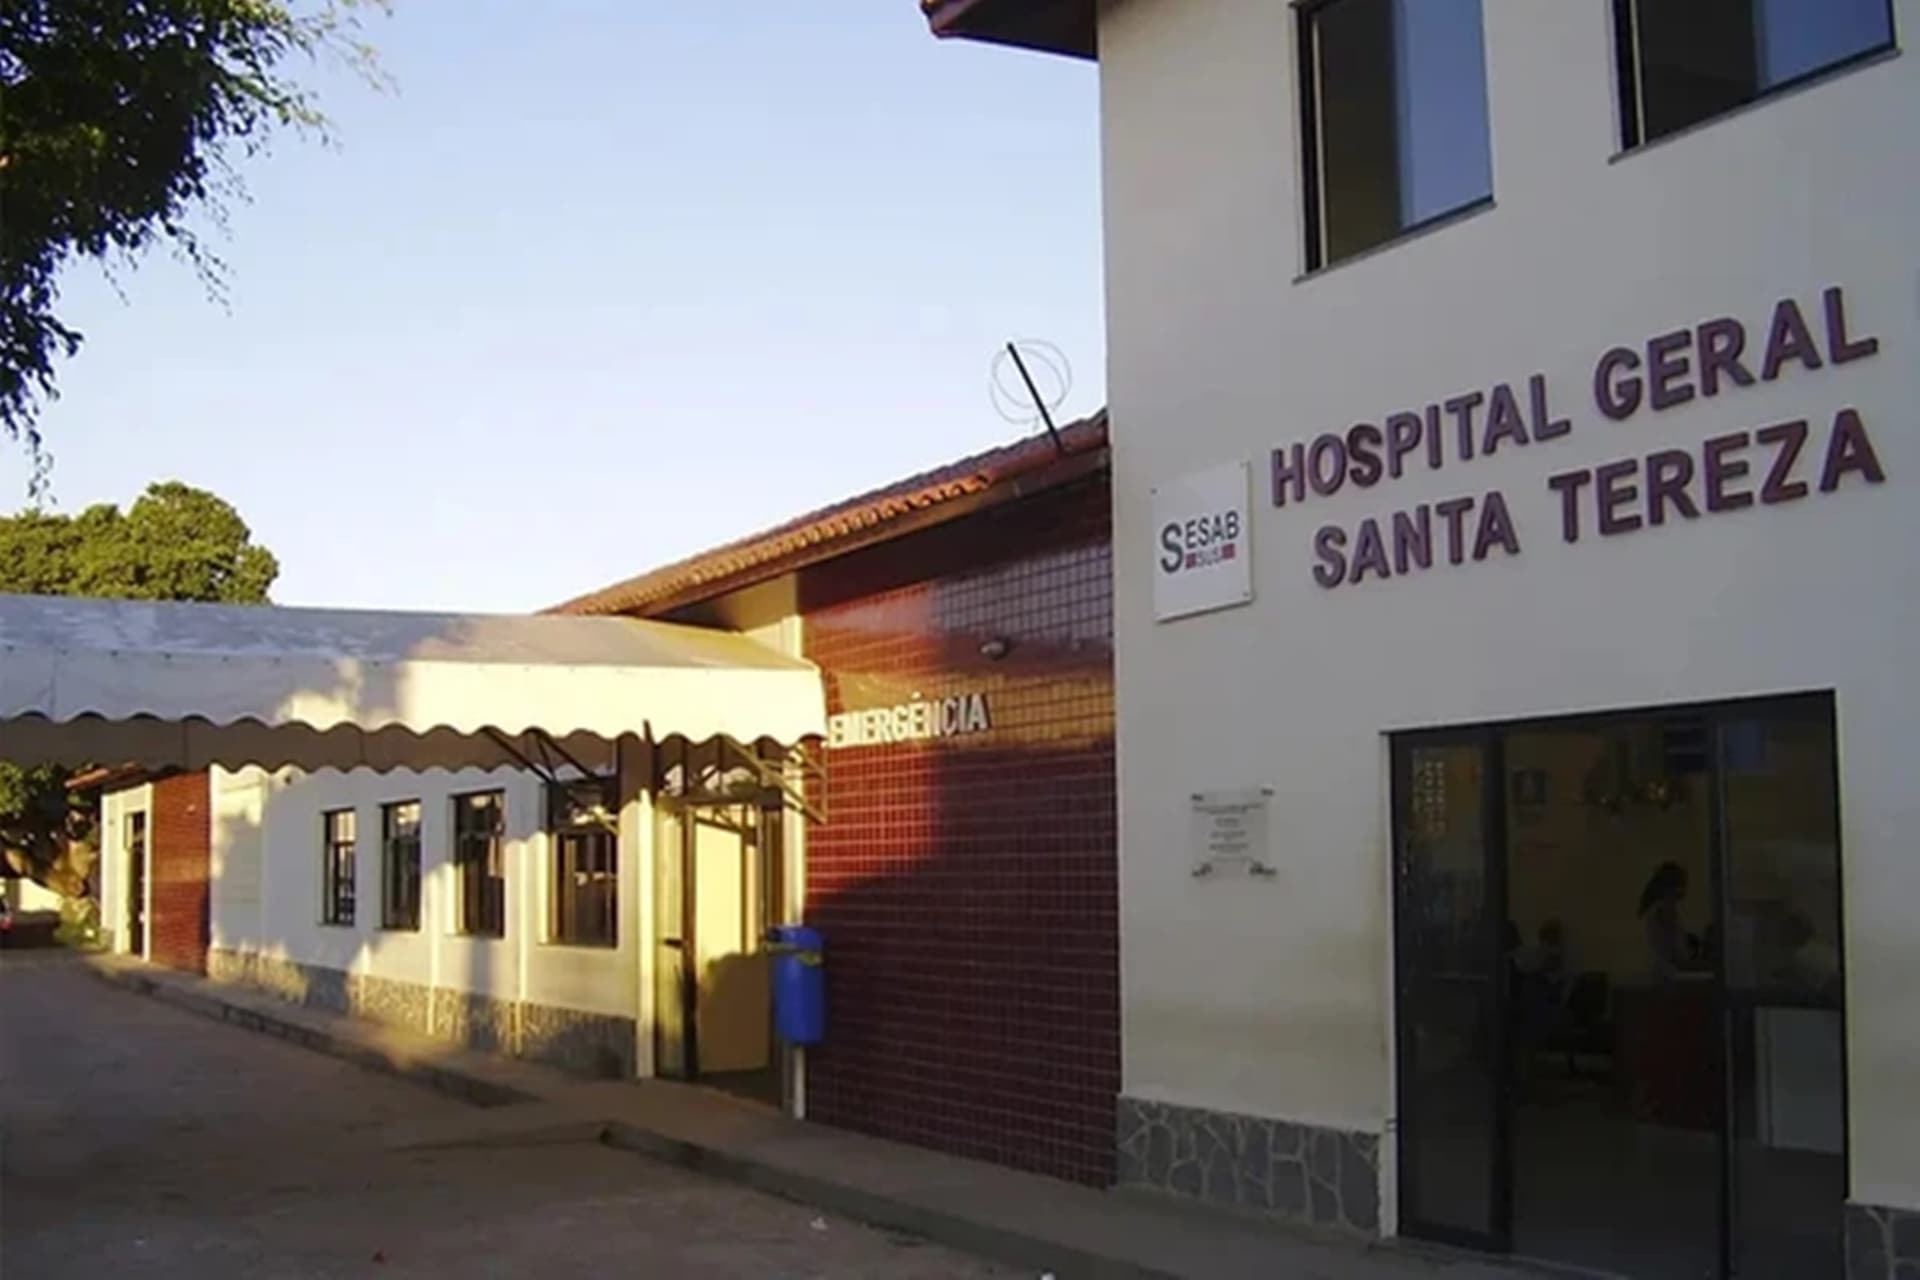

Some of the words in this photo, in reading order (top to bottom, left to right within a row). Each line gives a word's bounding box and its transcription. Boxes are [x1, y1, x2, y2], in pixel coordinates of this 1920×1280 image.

[1271, 373, 1573, 509] HOSPITAL
[1593, 286, 1880, 423] GERAL
[1161, 510, 1239, 574] SESAB
[1312, 490, 1522, 590] SANTA
[1547, 408, 1887, 545] TEREZA
